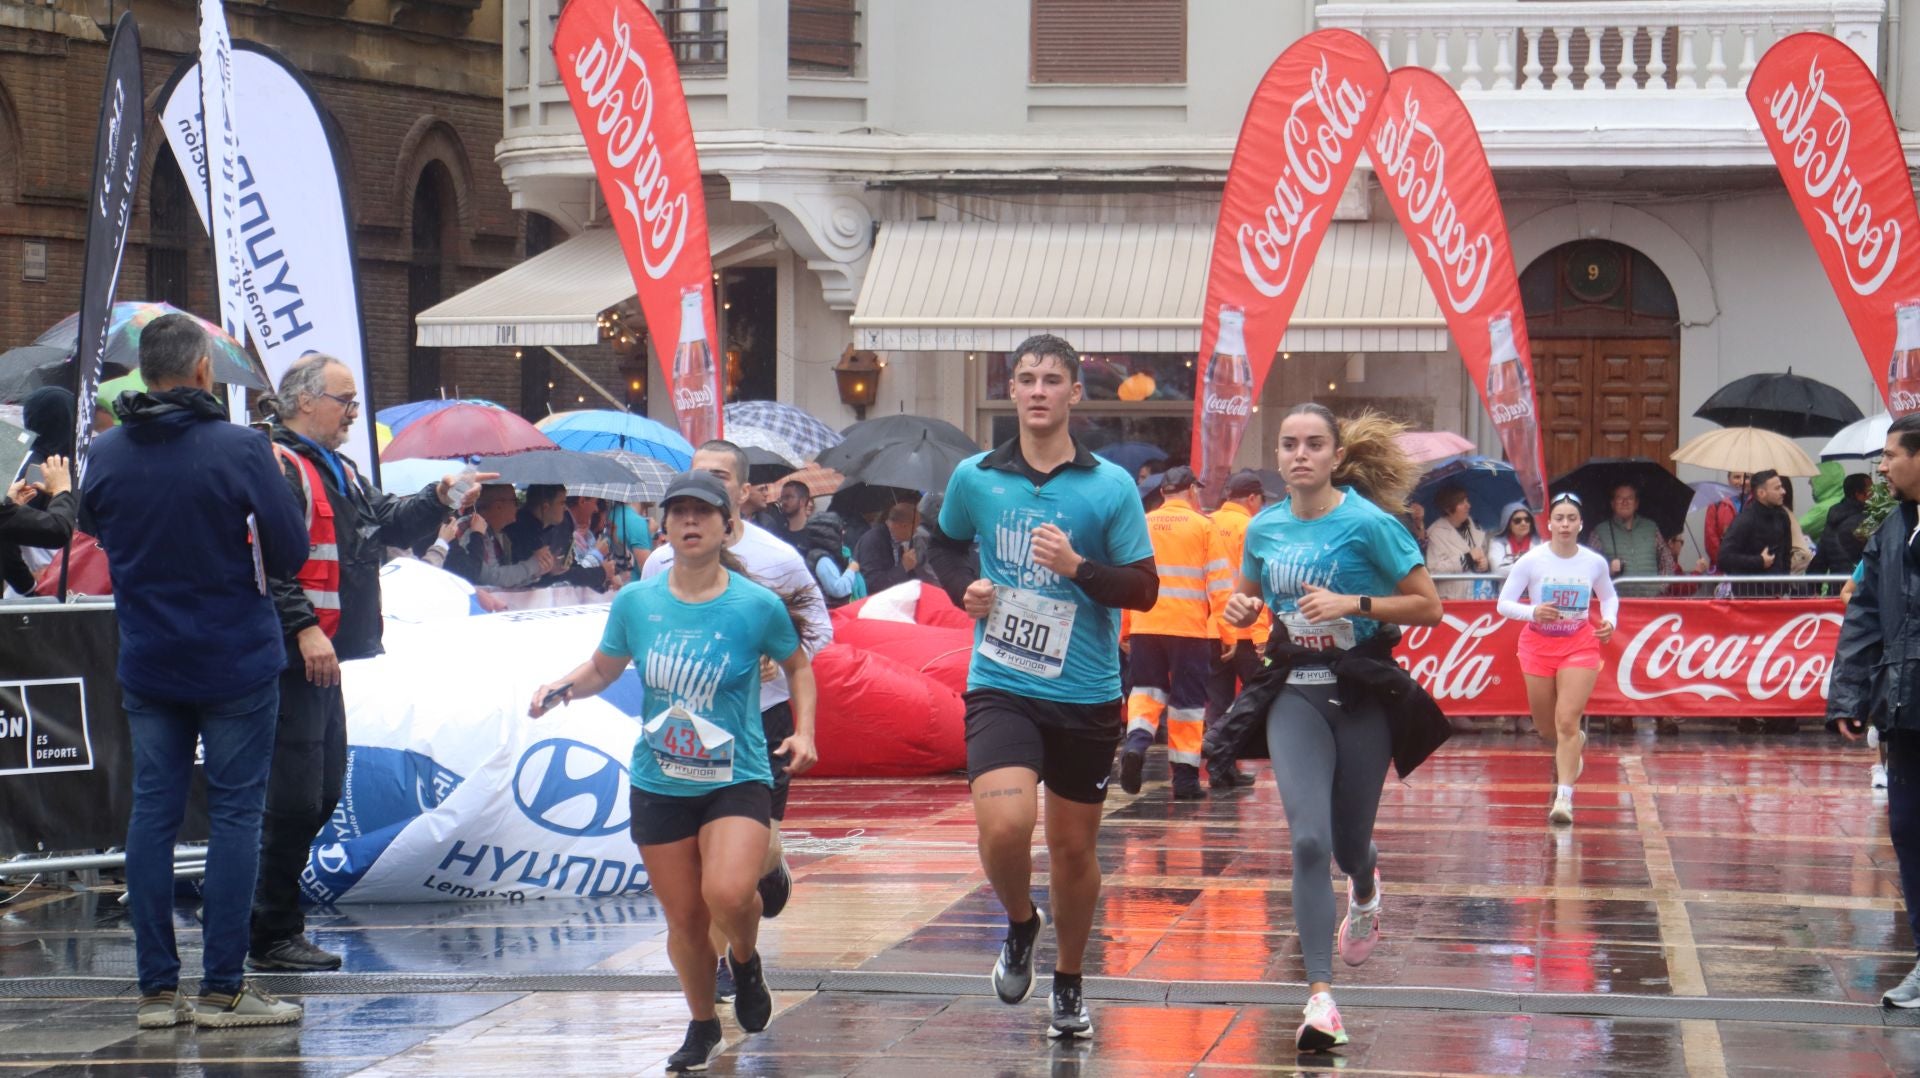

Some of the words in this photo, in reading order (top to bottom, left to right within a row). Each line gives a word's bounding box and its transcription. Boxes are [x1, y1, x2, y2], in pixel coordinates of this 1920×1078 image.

[1236, 51, 1367, 298] Coca-Cola
[1587, 264, 1600, 281] 9
[1205, 393, 1250, 416] Coca-Cola
[1153, 523, 1173, 531] CIVIL
[1552, 590, 1579, 607] 567
[1002, 613, 1050, 653] 930
[1007, 655, 1048, 672] HYUNDAI
[1307, 671, 1332, 679] HYUN
[36, 734, 48, 746] ES
[36, 747, 77, 760] DEPORTE
[674, 765, 717, 777] HYUNDAI
[345, 750, 357, 813] Automoción
[438, 839, 652, 897] HYUNDA
